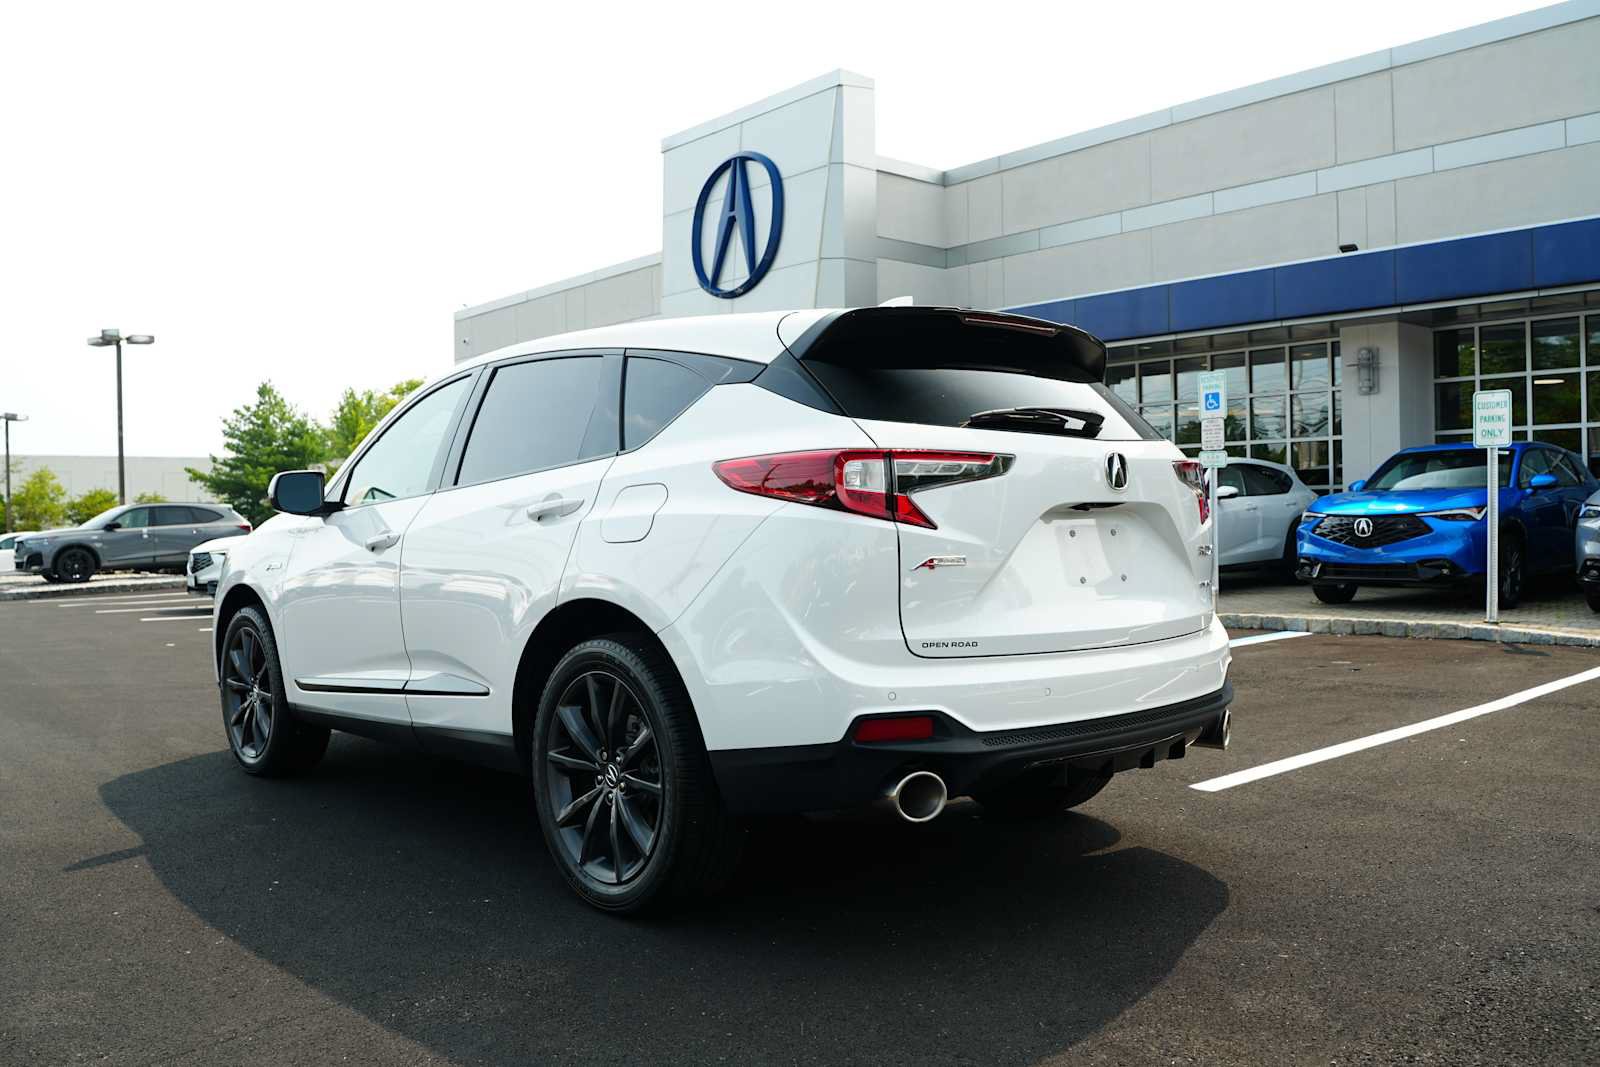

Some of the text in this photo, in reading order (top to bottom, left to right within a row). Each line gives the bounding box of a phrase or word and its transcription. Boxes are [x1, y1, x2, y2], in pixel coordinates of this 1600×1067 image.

[1477, 400, 1508, 410] CUSTOMER
[1479, 414, 1505, 424] PARKING
[1481, 428, 1504, 438] ONLY
